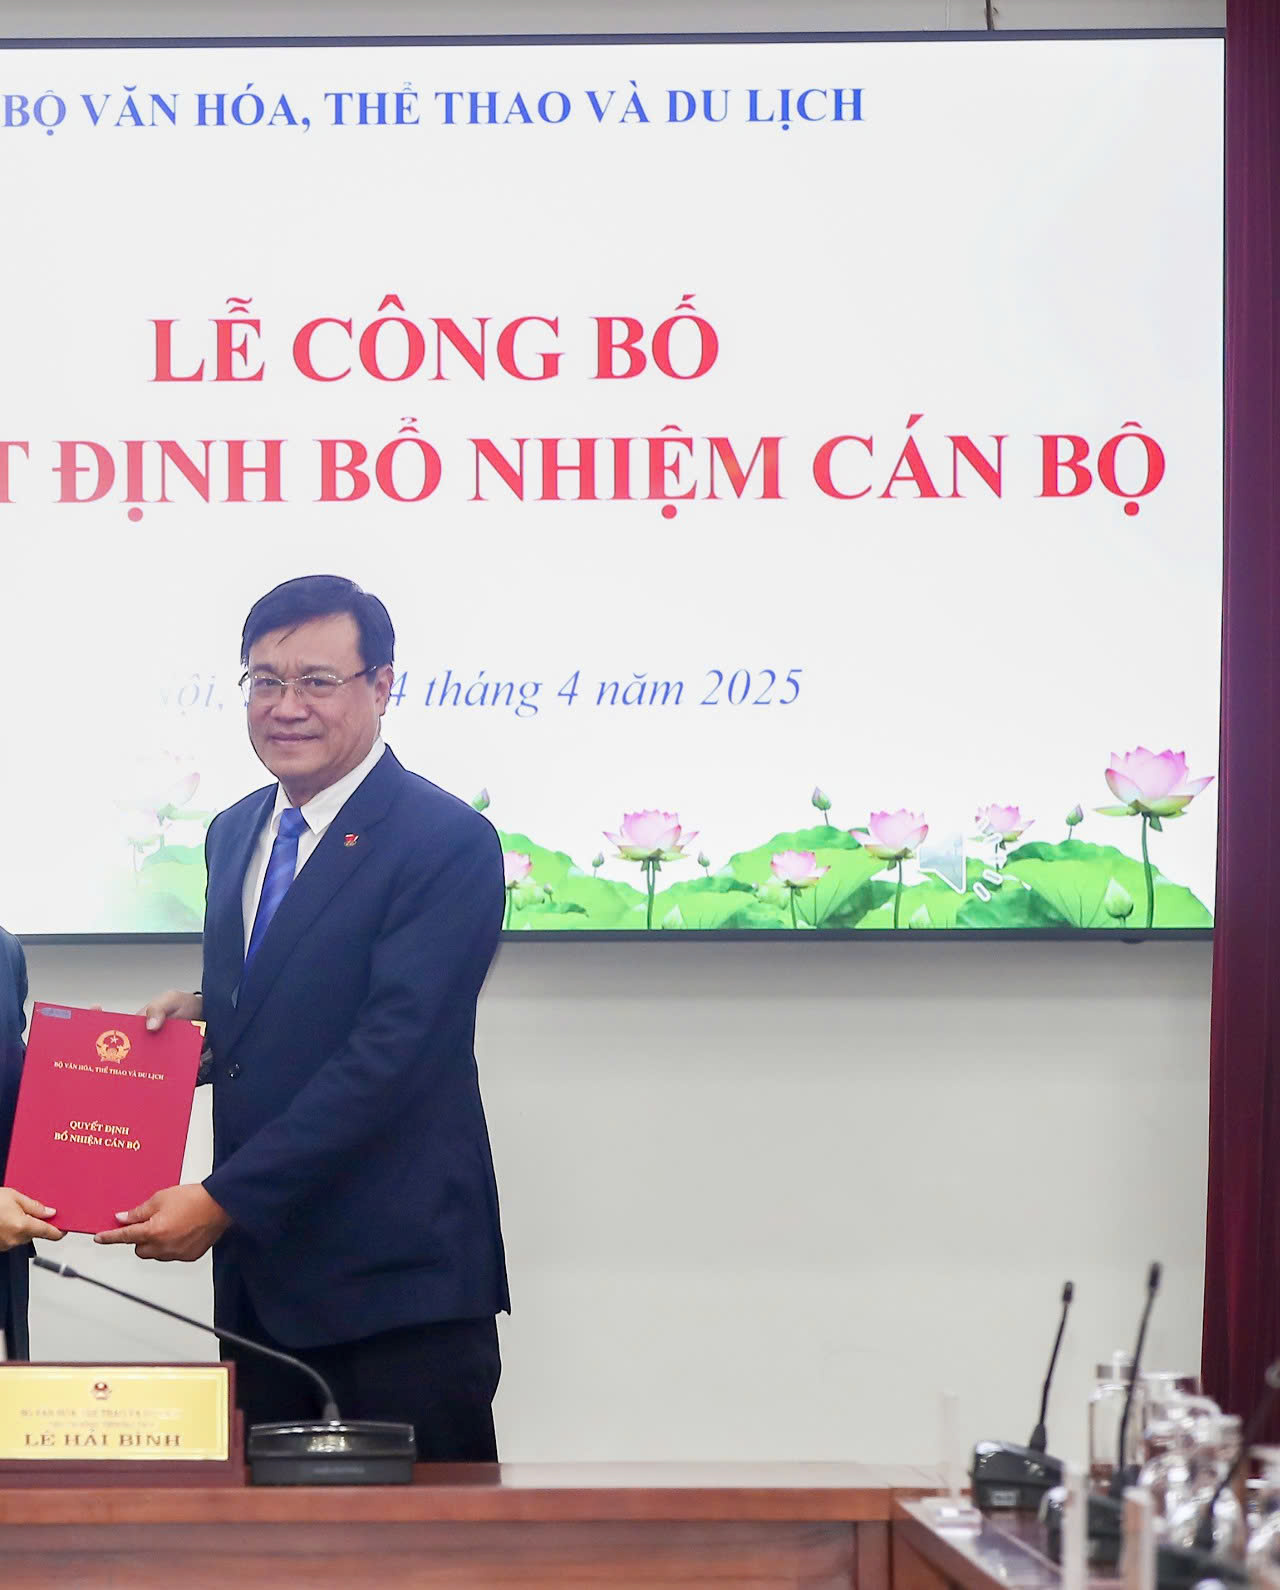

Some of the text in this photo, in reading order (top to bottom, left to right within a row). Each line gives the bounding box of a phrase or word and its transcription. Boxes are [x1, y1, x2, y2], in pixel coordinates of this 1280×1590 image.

[1, 79, 865, 136] BỘ VĂN HÓA, THỂ THAO VÀ DU LỊCH
[152, 293, 720, 383] LỄ CÔNG BỐ
[53, 439, 285, 522] ĐỊNH
[319, 417, 443, 503] BỔ
[470, 423, 783, 520] NHIỆM
[812, 413, 1007, 501] CÁN
[1039, 420, 1167, 517] BỘ
[159, 672, 224, 716] ội,
[425, 670, 541, 717] tháng
[557, 671, 580, 705] 4
[596, 673, 685, 706] năm
[700, 668, 803, 706] 2025
[70, 1120, 104, 1131] QUYẾT
[70, 1134, 102, 1146] NHIỆM
[104, 1138, 125, 1148] CÁN
[126, 1140, 141, 1151] BỘ
